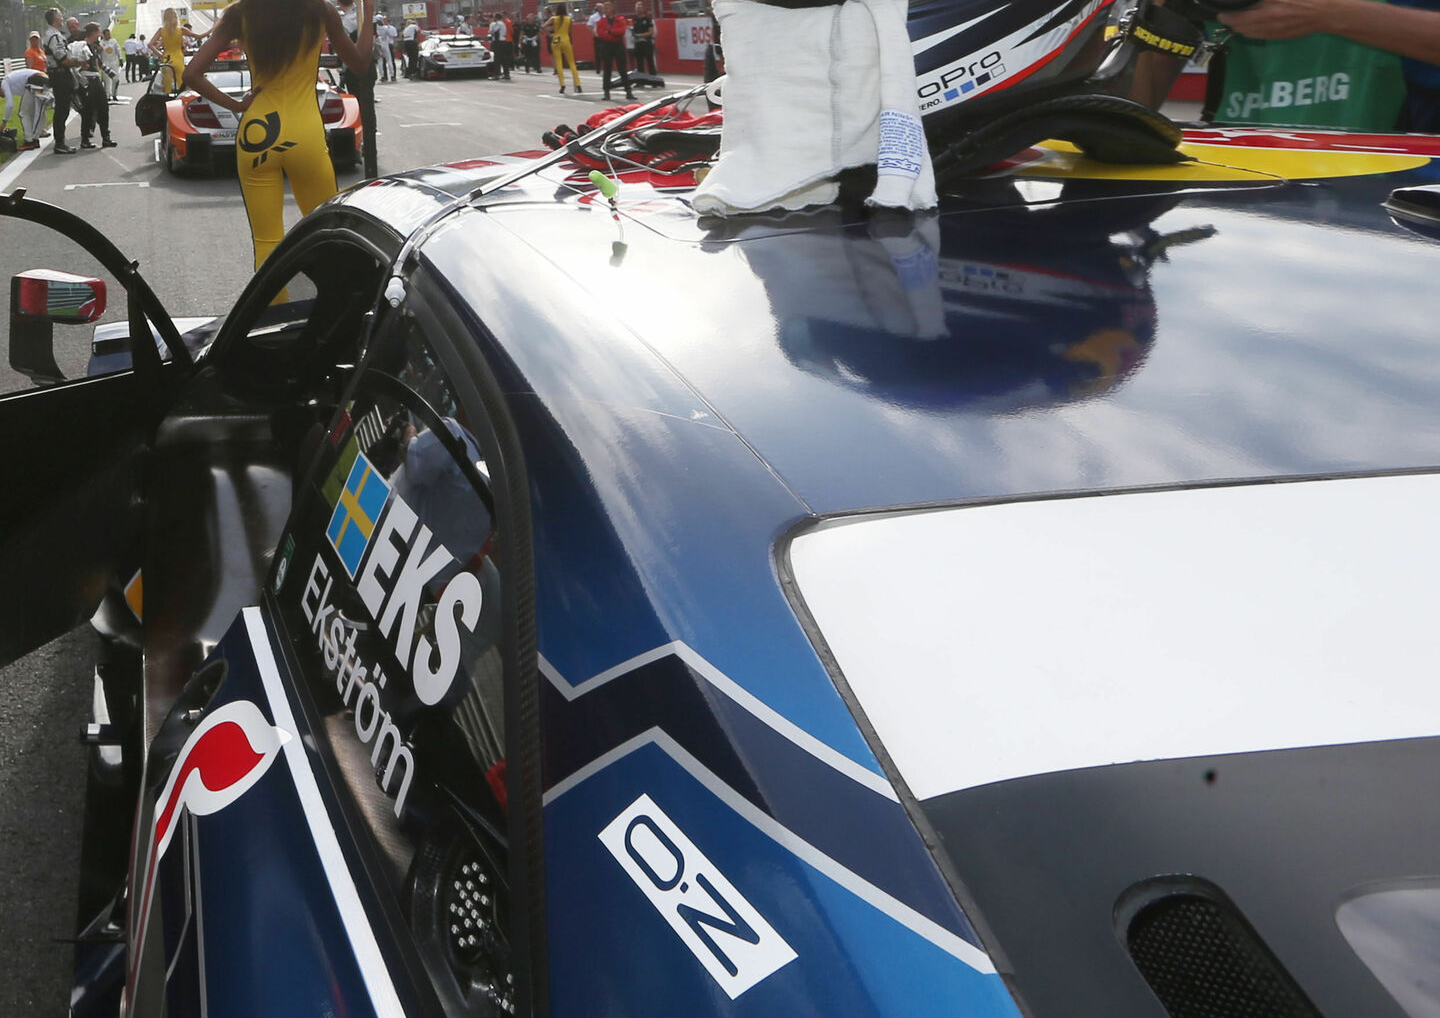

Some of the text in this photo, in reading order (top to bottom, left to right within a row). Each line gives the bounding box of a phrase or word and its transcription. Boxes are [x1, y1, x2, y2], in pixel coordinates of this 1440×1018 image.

[917, 51, 1001, 99] oPro
[919, 98, 942, 111] ERO.
[357, 495, 483, 706] EKS
[301, 553, 415, 819] Ekström
